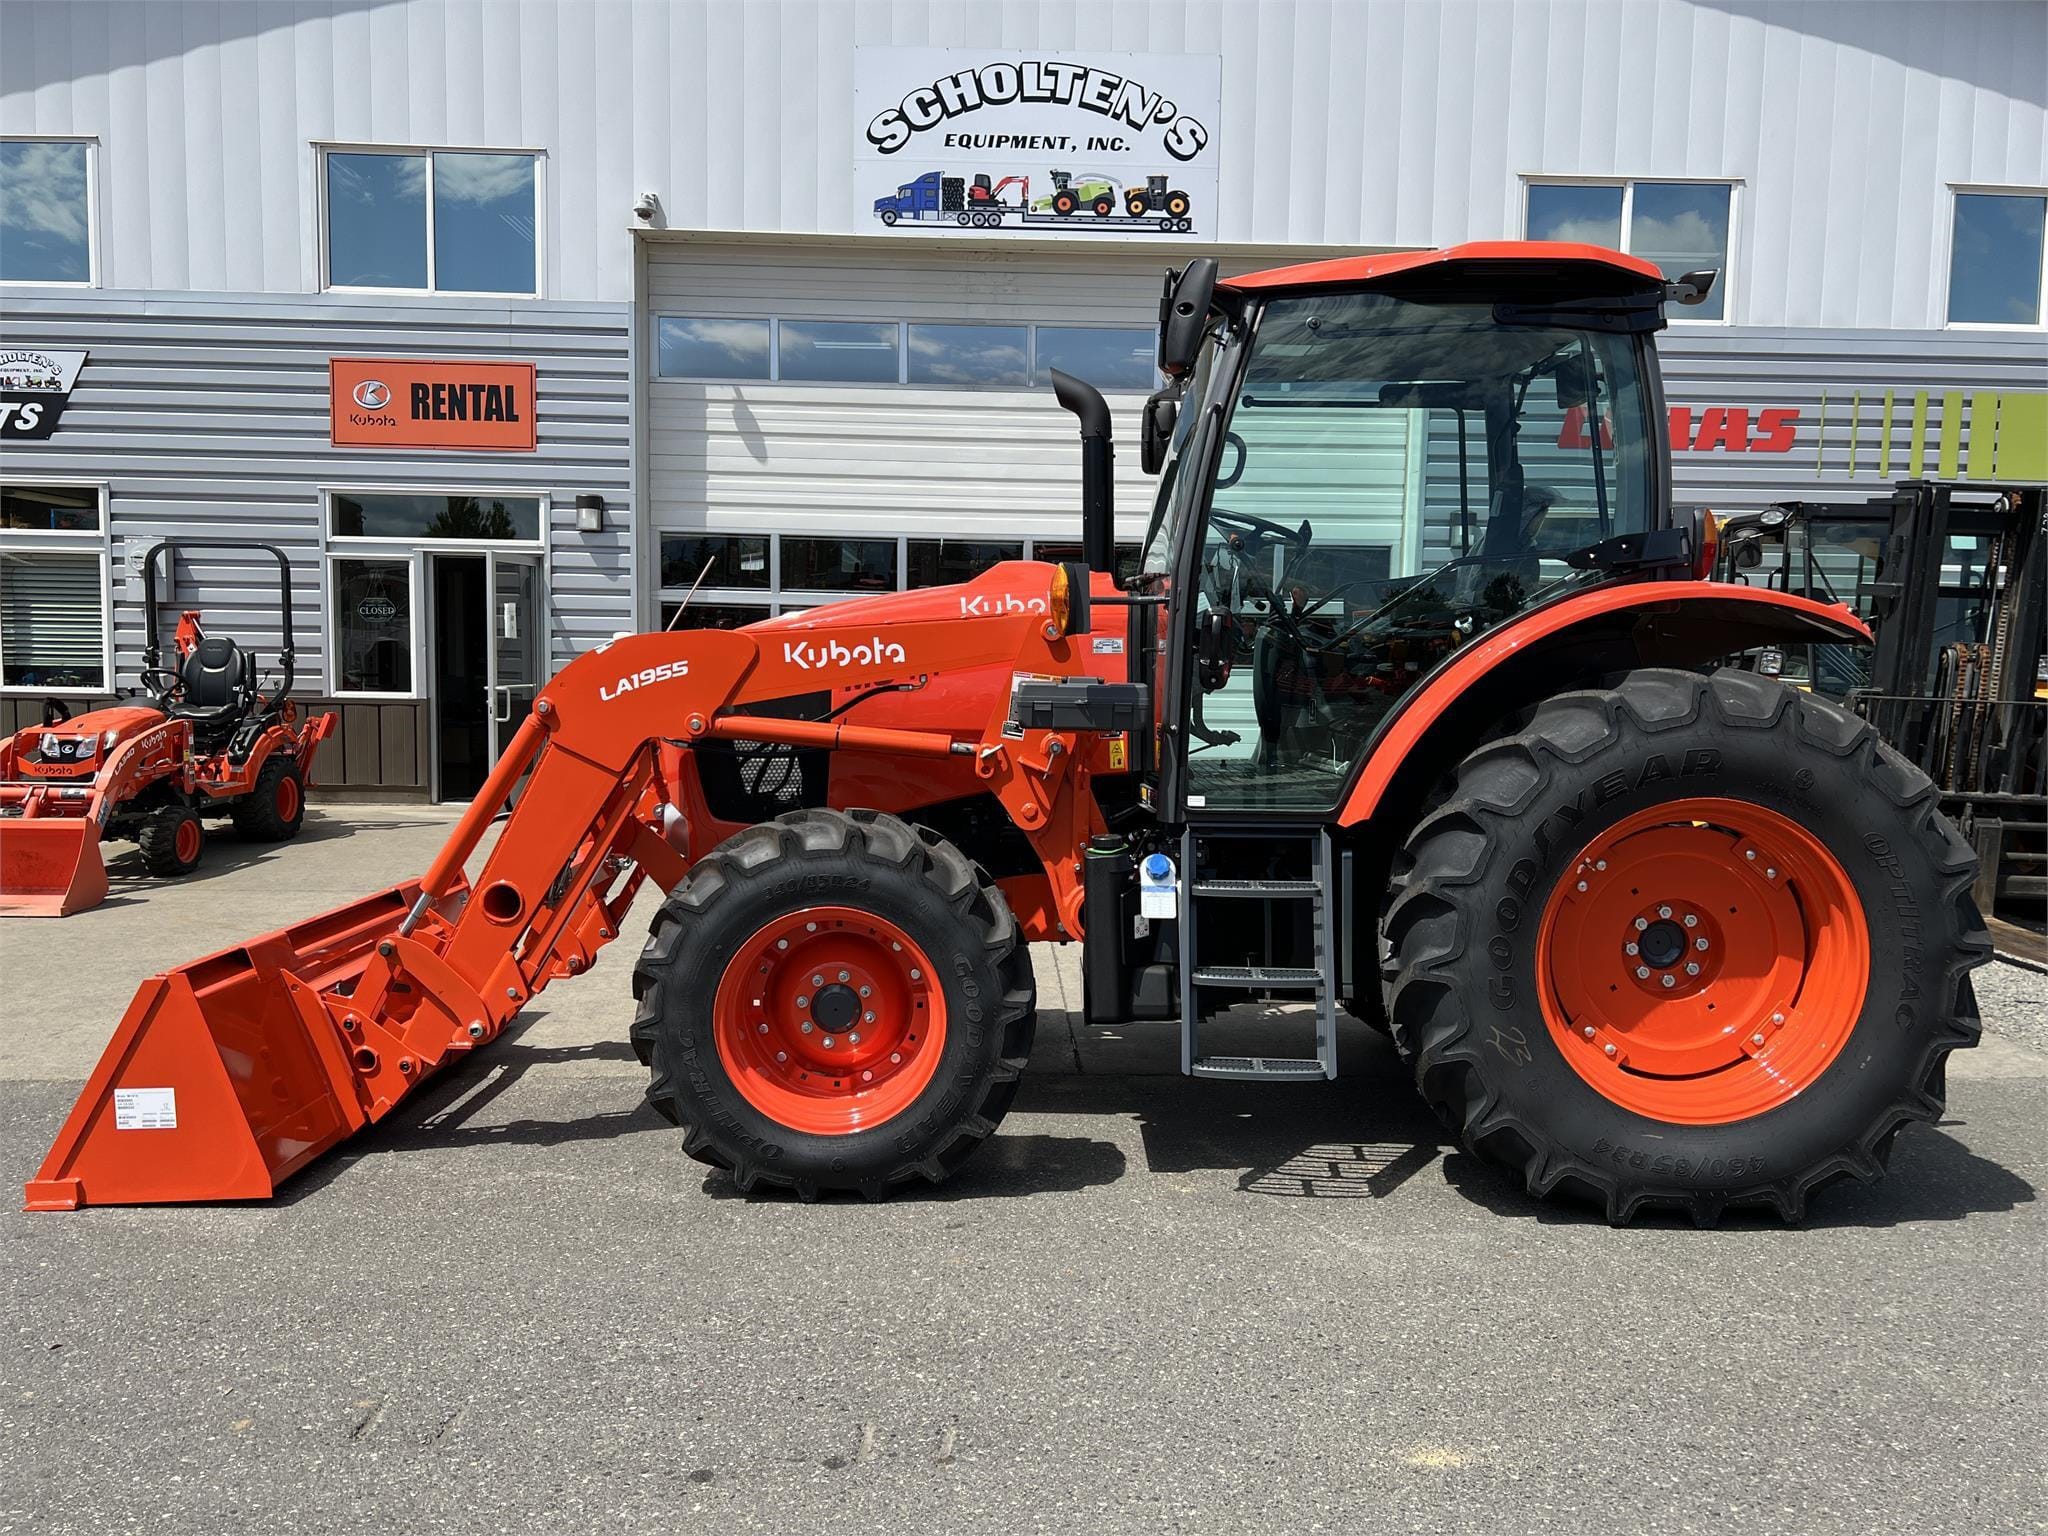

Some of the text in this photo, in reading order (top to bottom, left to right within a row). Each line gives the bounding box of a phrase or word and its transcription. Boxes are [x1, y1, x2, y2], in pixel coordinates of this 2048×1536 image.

[866, 61, 1208, 161] SCHOLTEN'S
[944, 134, 1131, 152] EQUIPMENT, INC.
[411, 383, 519, 422] RENTAL
[350, 414, 396, 427] Kubota
[360, 606, 395, 615] CLOSED
[960, 592, 1050, 618] Kubo
[784, 637, 906, 669] Kubota
[600, 660, 689, 701] LA1955
[141, 730, 167, 749] Kubota
[34, 766, 73, 776] Kubota
[1488, 746, 1724, 1011] GOODYEAR
